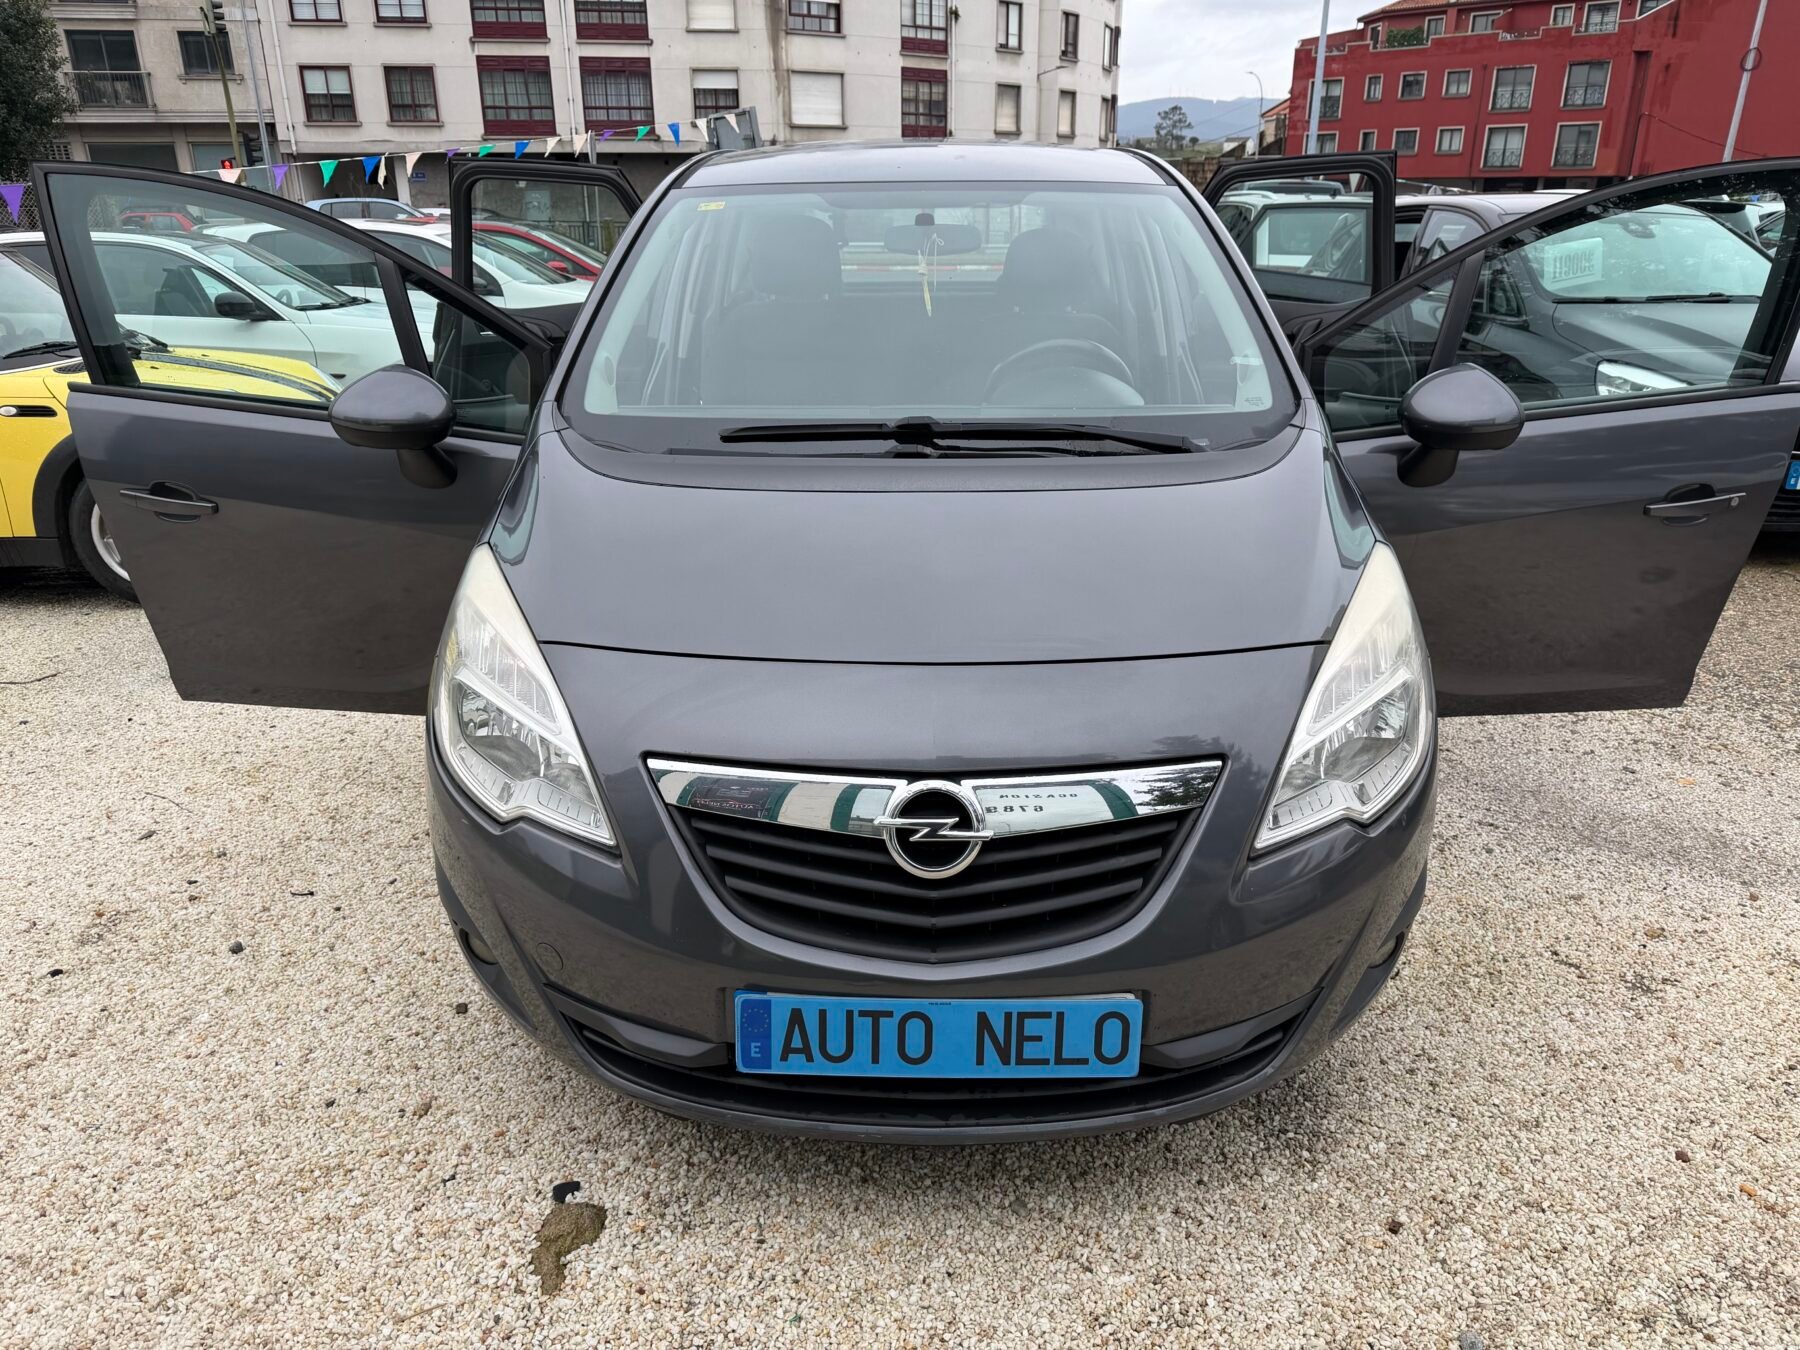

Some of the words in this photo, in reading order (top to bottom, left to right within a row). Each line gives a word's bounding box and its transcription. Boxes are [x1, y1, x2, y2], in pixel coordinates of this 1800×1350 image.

[1553, 250, 1595, 279] 11900€
[750, 1042, 761, 1057] E
[779, 1008, 934, 1065] AUTO
[975, 1010, 1131, 1066] NELO
